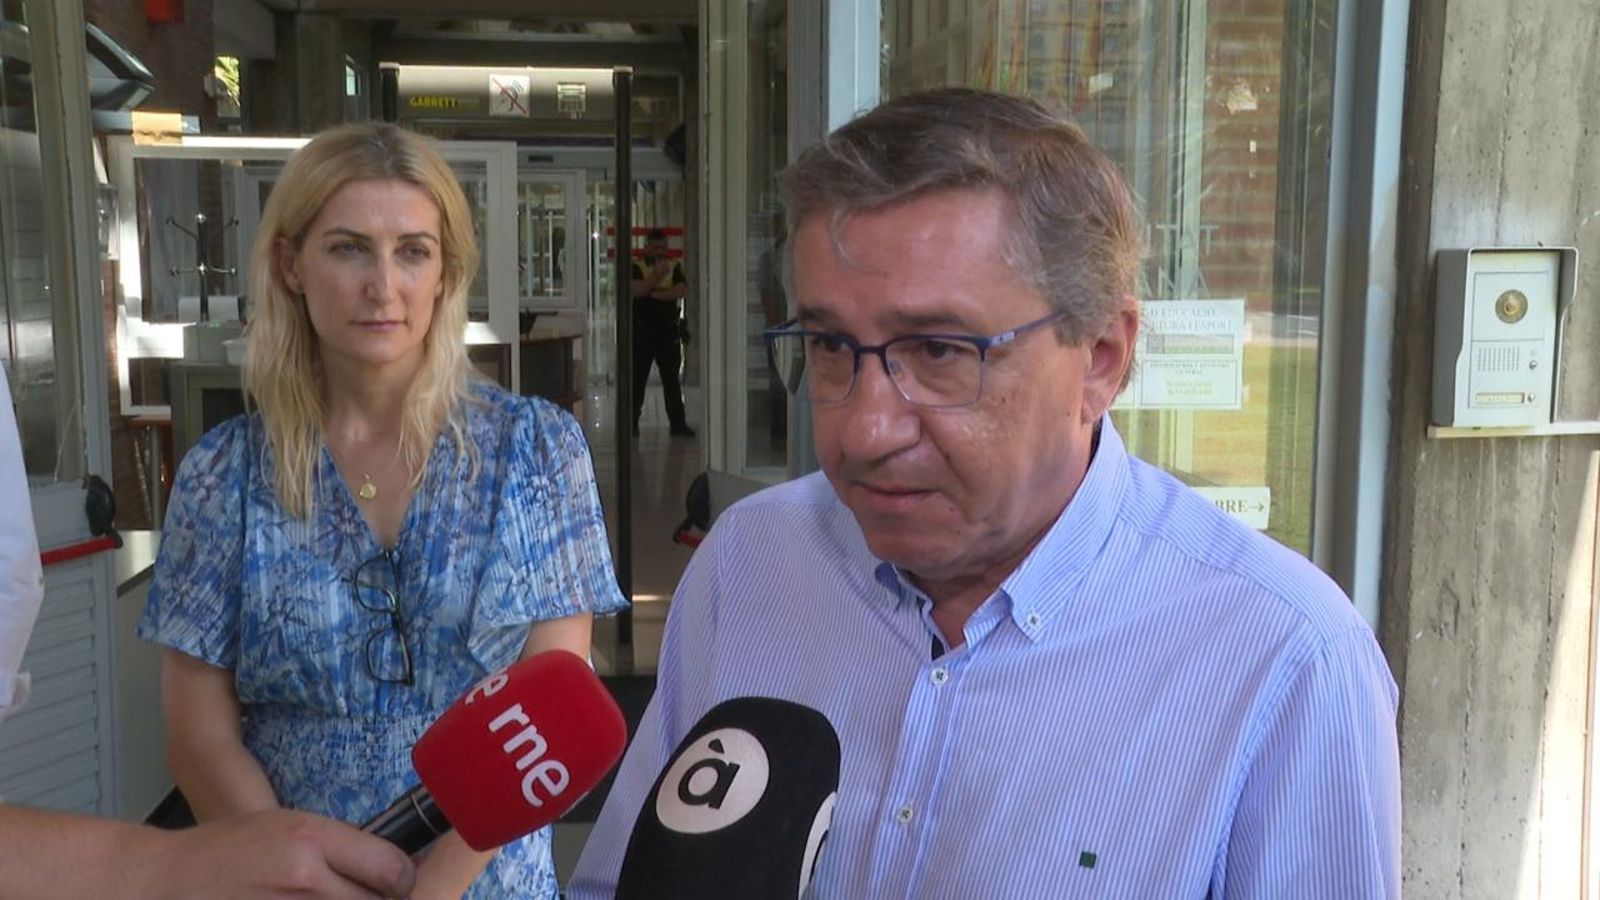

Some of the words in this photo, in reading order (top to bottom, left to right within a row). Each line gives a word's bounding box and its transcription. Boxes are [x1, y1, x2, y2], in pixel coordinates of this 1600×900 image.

[409, 97, 457, 108] GARRETT
[488, 703, 570, 807] rne
[678, 738, 740, 810] à
